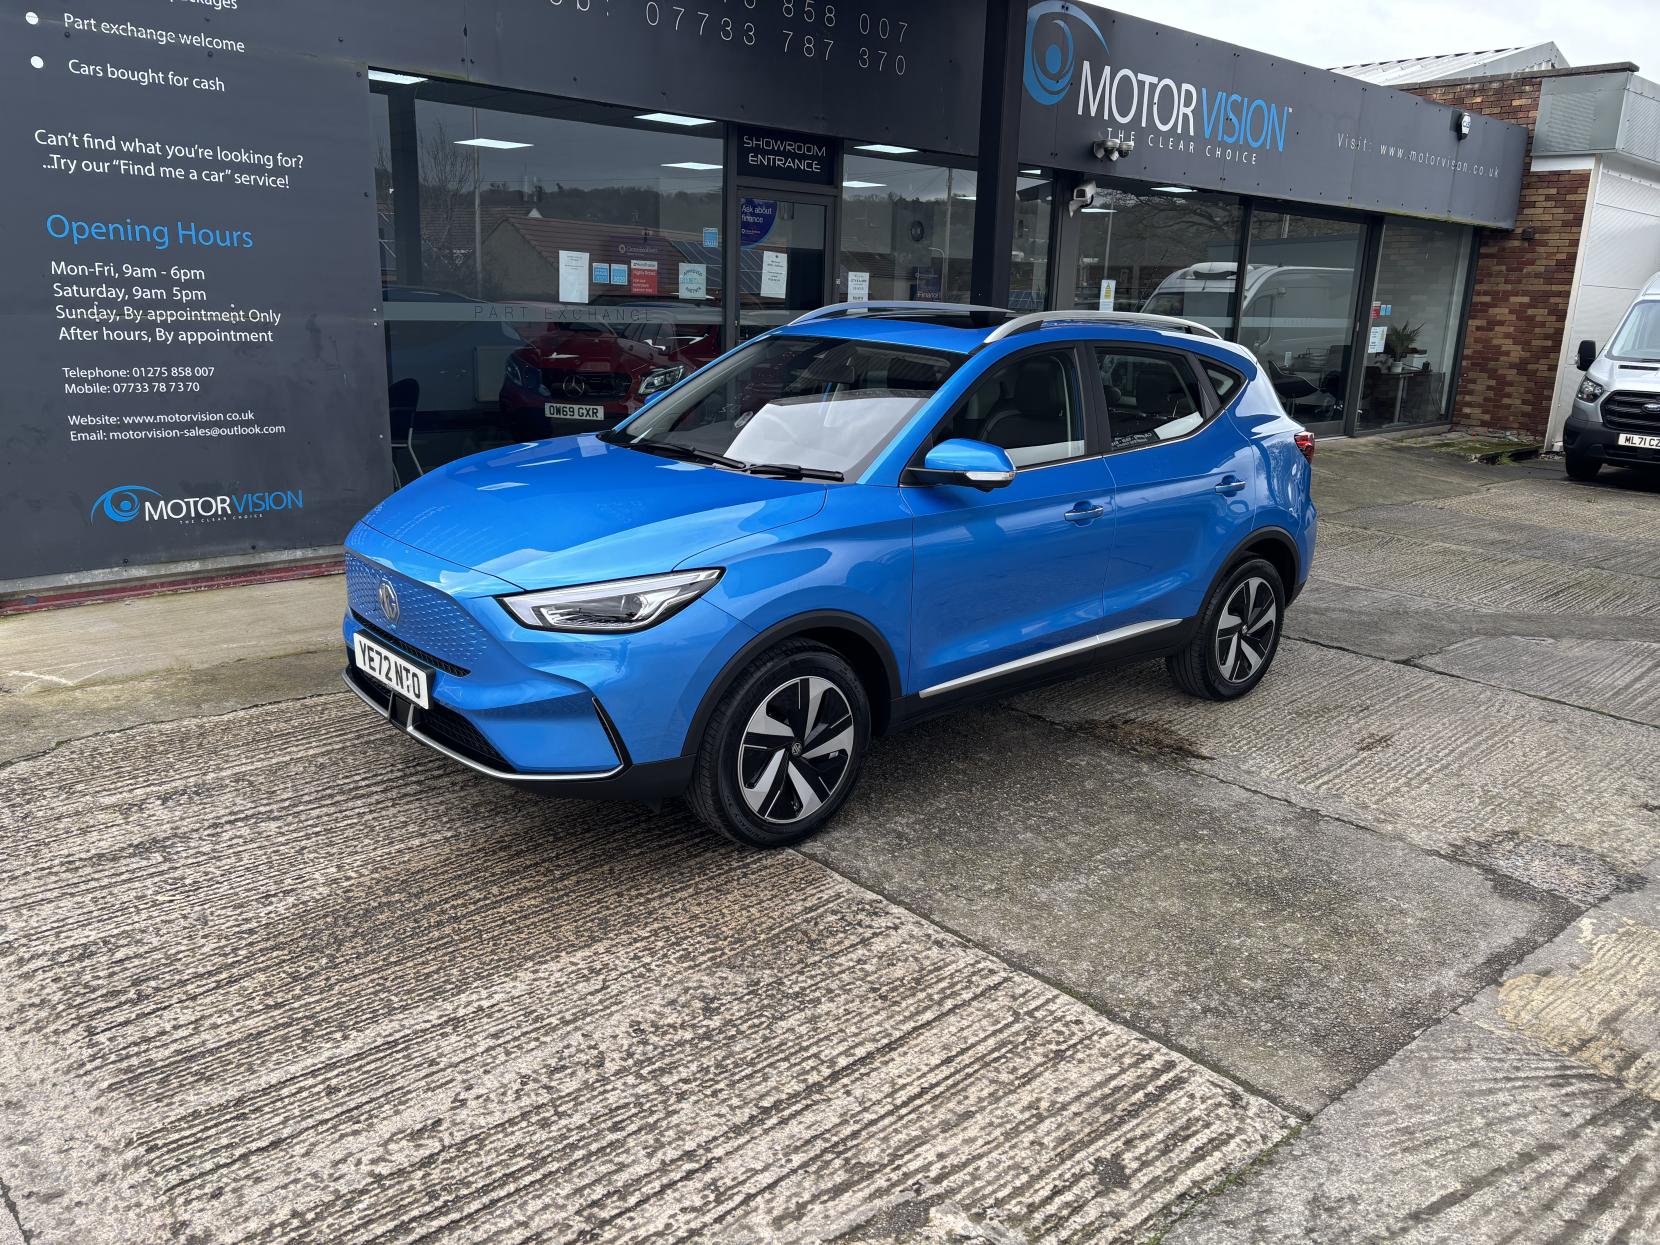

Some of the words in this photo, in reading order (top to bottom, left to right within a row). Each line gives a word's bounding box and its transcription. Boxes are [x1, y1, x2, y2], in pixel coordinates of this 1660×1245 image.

[783, 0, 836, 26] 858
[859, 13, 908, 43] 007
[64, 13, 97, 31] Part
[100, 22, 176, 45] exchange
[178, 33, 246, 53] welcome
[646, 2, 756, 46] 07733
[783, 30, 834, 61] 787
[858, 47, 906, 75] 370
[68, 59, 103, 77] Cars
[107, 62, 165, 86] bought
[168, 71, 190, 88] for
[192, 76, 226, 92] cash
[34, 129, 79, 148] Can't
[83, 133, 116, 151] find
[120, 138, 162, 156] what
[166, 144, 213, 161] you're
[217, 146, 274, 169] looking
[277, 152, 304, 169] for?
[743, 135, 826, 157] SHOWROOM
[1107, 128, 1136, 147] THE
[1148, 134, 1195, 153] CLEAR
[1205, 145, 1257, 165] CHOICE
[748, 153, 821, 172] ENTRANCE
[81, 160, 110, 173] our
[112, 160, 155, 177] "Find
[160, 167, 185, 179] me
[189, 170, 198, 180] a
[202, 169, 231, 183] car"
[234, 172, 290, 189] service!
[741, 204, 754, 213] Ask
[754, 205, 772, 214] about
[46, 213, 169, 249] Opening
[178, 221, 254, 248] Hours
[51, 261, 119, 278] Mon-Fri,
[122, 263, 157, 278] 9am
[170, 265, 205, 282] 6pm
[53, 283, 129, 302] Saturday,
[132, 286, 167, 299] 9am
[172, 287, 207, 303] 5pm
[55, 304, 120, 323] Sunday,
[123, 305, 143, 323] By
[147, 307, 246, 324] appointment
[249, 308, 282, 326] Only
[474, 306, 529, 320] PART
[58, 326, 99, 341] After
[103, 326, 152, 343] hours,
[155, 327, 175, 344] By
[178, 328, 275, 345] appointment
[62, 367, 130, 381] Telephone:
[132, 367, 168, 378] 01275
[171, 367, 192, 377] 858
[194, 366, 215, 377] 007
[64, 382, 111, 395] Mobile:
[113, 382, 150, 393] 07733
[67, 414, 121, 426] Website:
[549, 404, 575, 417] OW69
[577, 407, 599, 418] GXR
[70, 430, 107, 441] Email:
[109, 423, 286, 440] motorvision-sales@outlook.com
[359, 639, 393, 683] YE72
[394, 660, 422, 700] NTO
